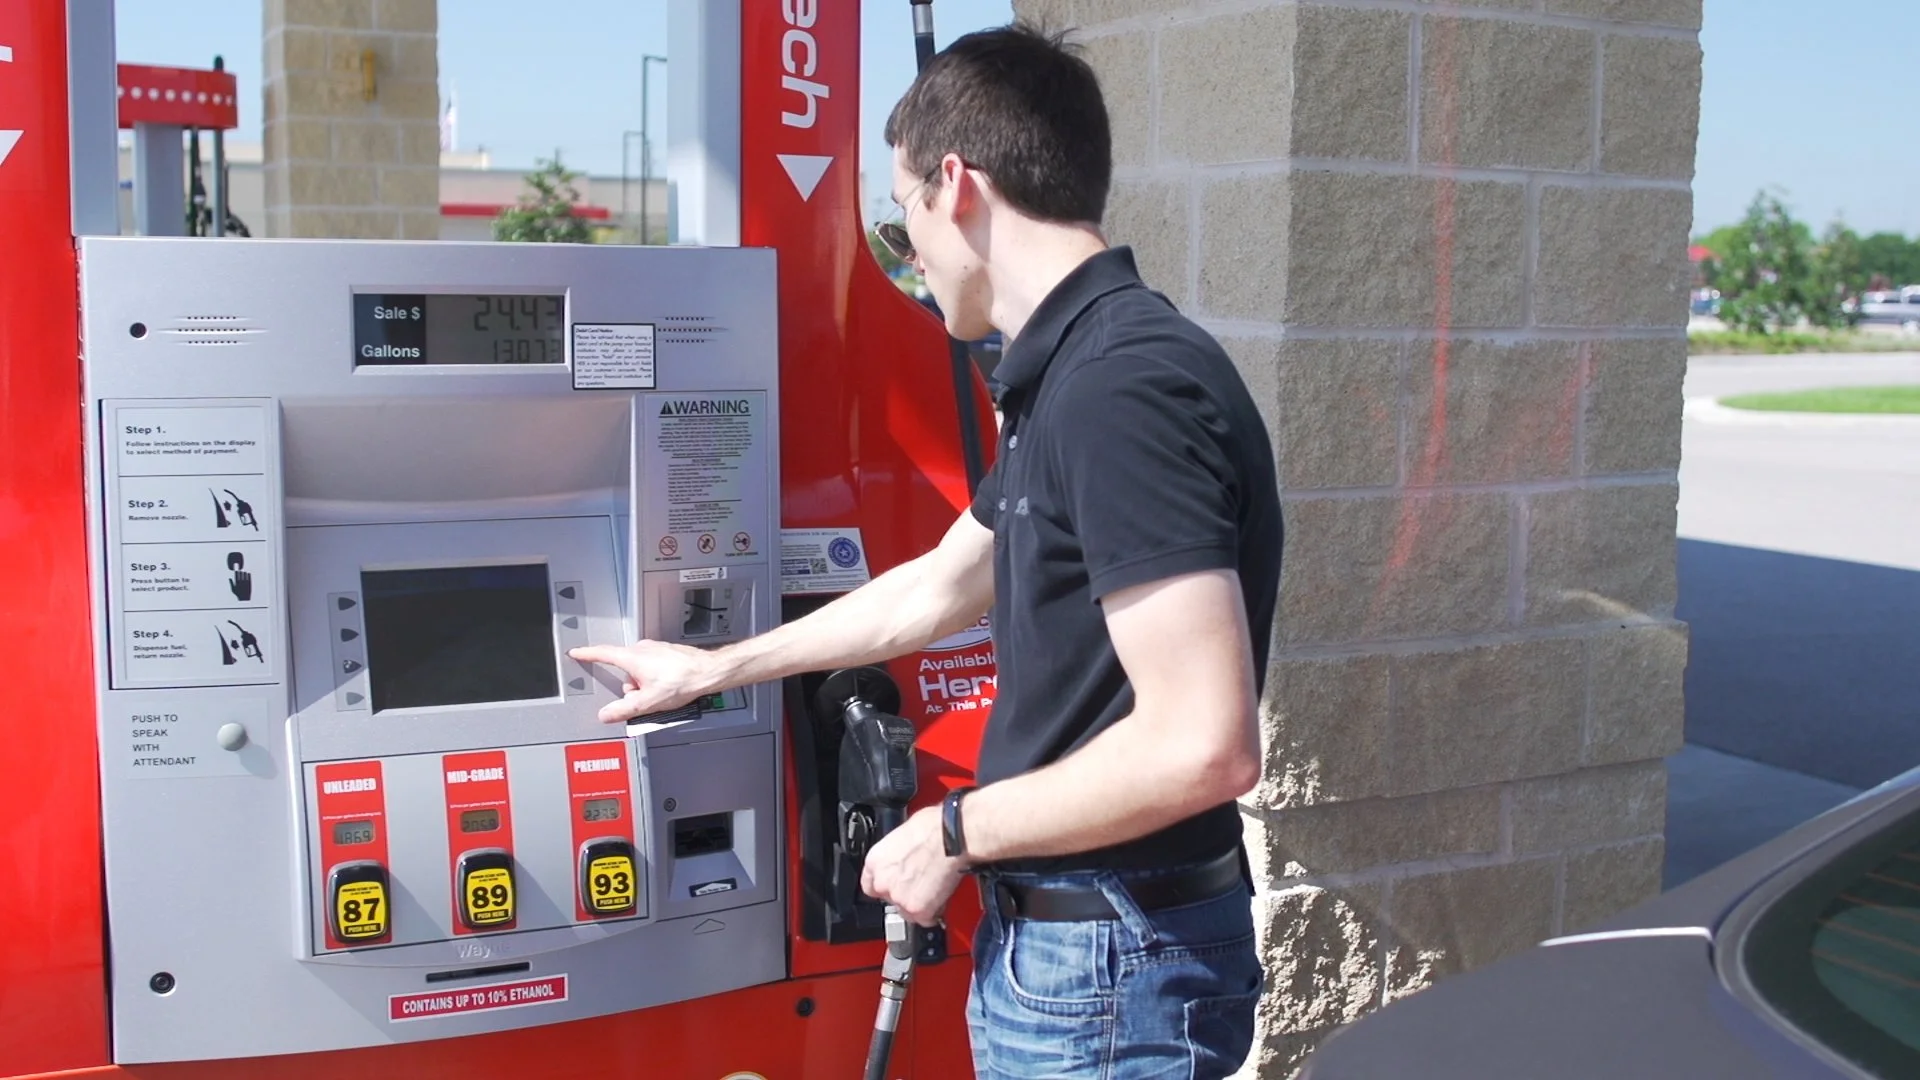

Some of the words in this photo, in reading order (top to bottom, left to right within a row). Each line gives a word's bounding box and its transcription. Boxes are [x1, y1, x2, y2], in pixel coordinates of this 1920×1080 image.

[374, 306, 407, 320] Sale
[411, 306, 421, 321] $
[361, 344, 420, 358] Gallons
[673, 399, 750, 414] WARNING
[125, 425, 152, 435] Step
[156, 426, 167, 434] 1.
[128, 500, 155, 510] Step
[158, 500, 169, 508] 2.
[130, 563, 157, 573] Step
[160, 562, 171, 570] 3.
[133, 630, 159, 640] Step
[163, 630, 174, 638] 4.
[918, 674, 998, 701] Her
[925, 704, 943, 714] At
[948, 700, 977, 712] This
[132, 714, 161, 723] PUSH
[164, 714, 178, 723] TO
[132, 729, 168, 738] SPEAK
[132, 744, 160, 752] WITH
[133, 757, 196, 766] ATTENDANT
[573, 758, 621, 773] PREMIUM
[446, 767, 504, 784] MID-GRADE
[323, 777, 377, 794] UNLEADED
[594, 872, 630, 896] 93
[472, 884, 508, 909] 89
[343, 897, 380, 923] 87
[402, 996, 453, 1014] CONTAINS
[456, 995, 470, 1008] UP
[472, 993, 485, 1006] TO
[488, 989, 508, 1003] 10%
[511, 984, 555, 1001] ETHANOL
